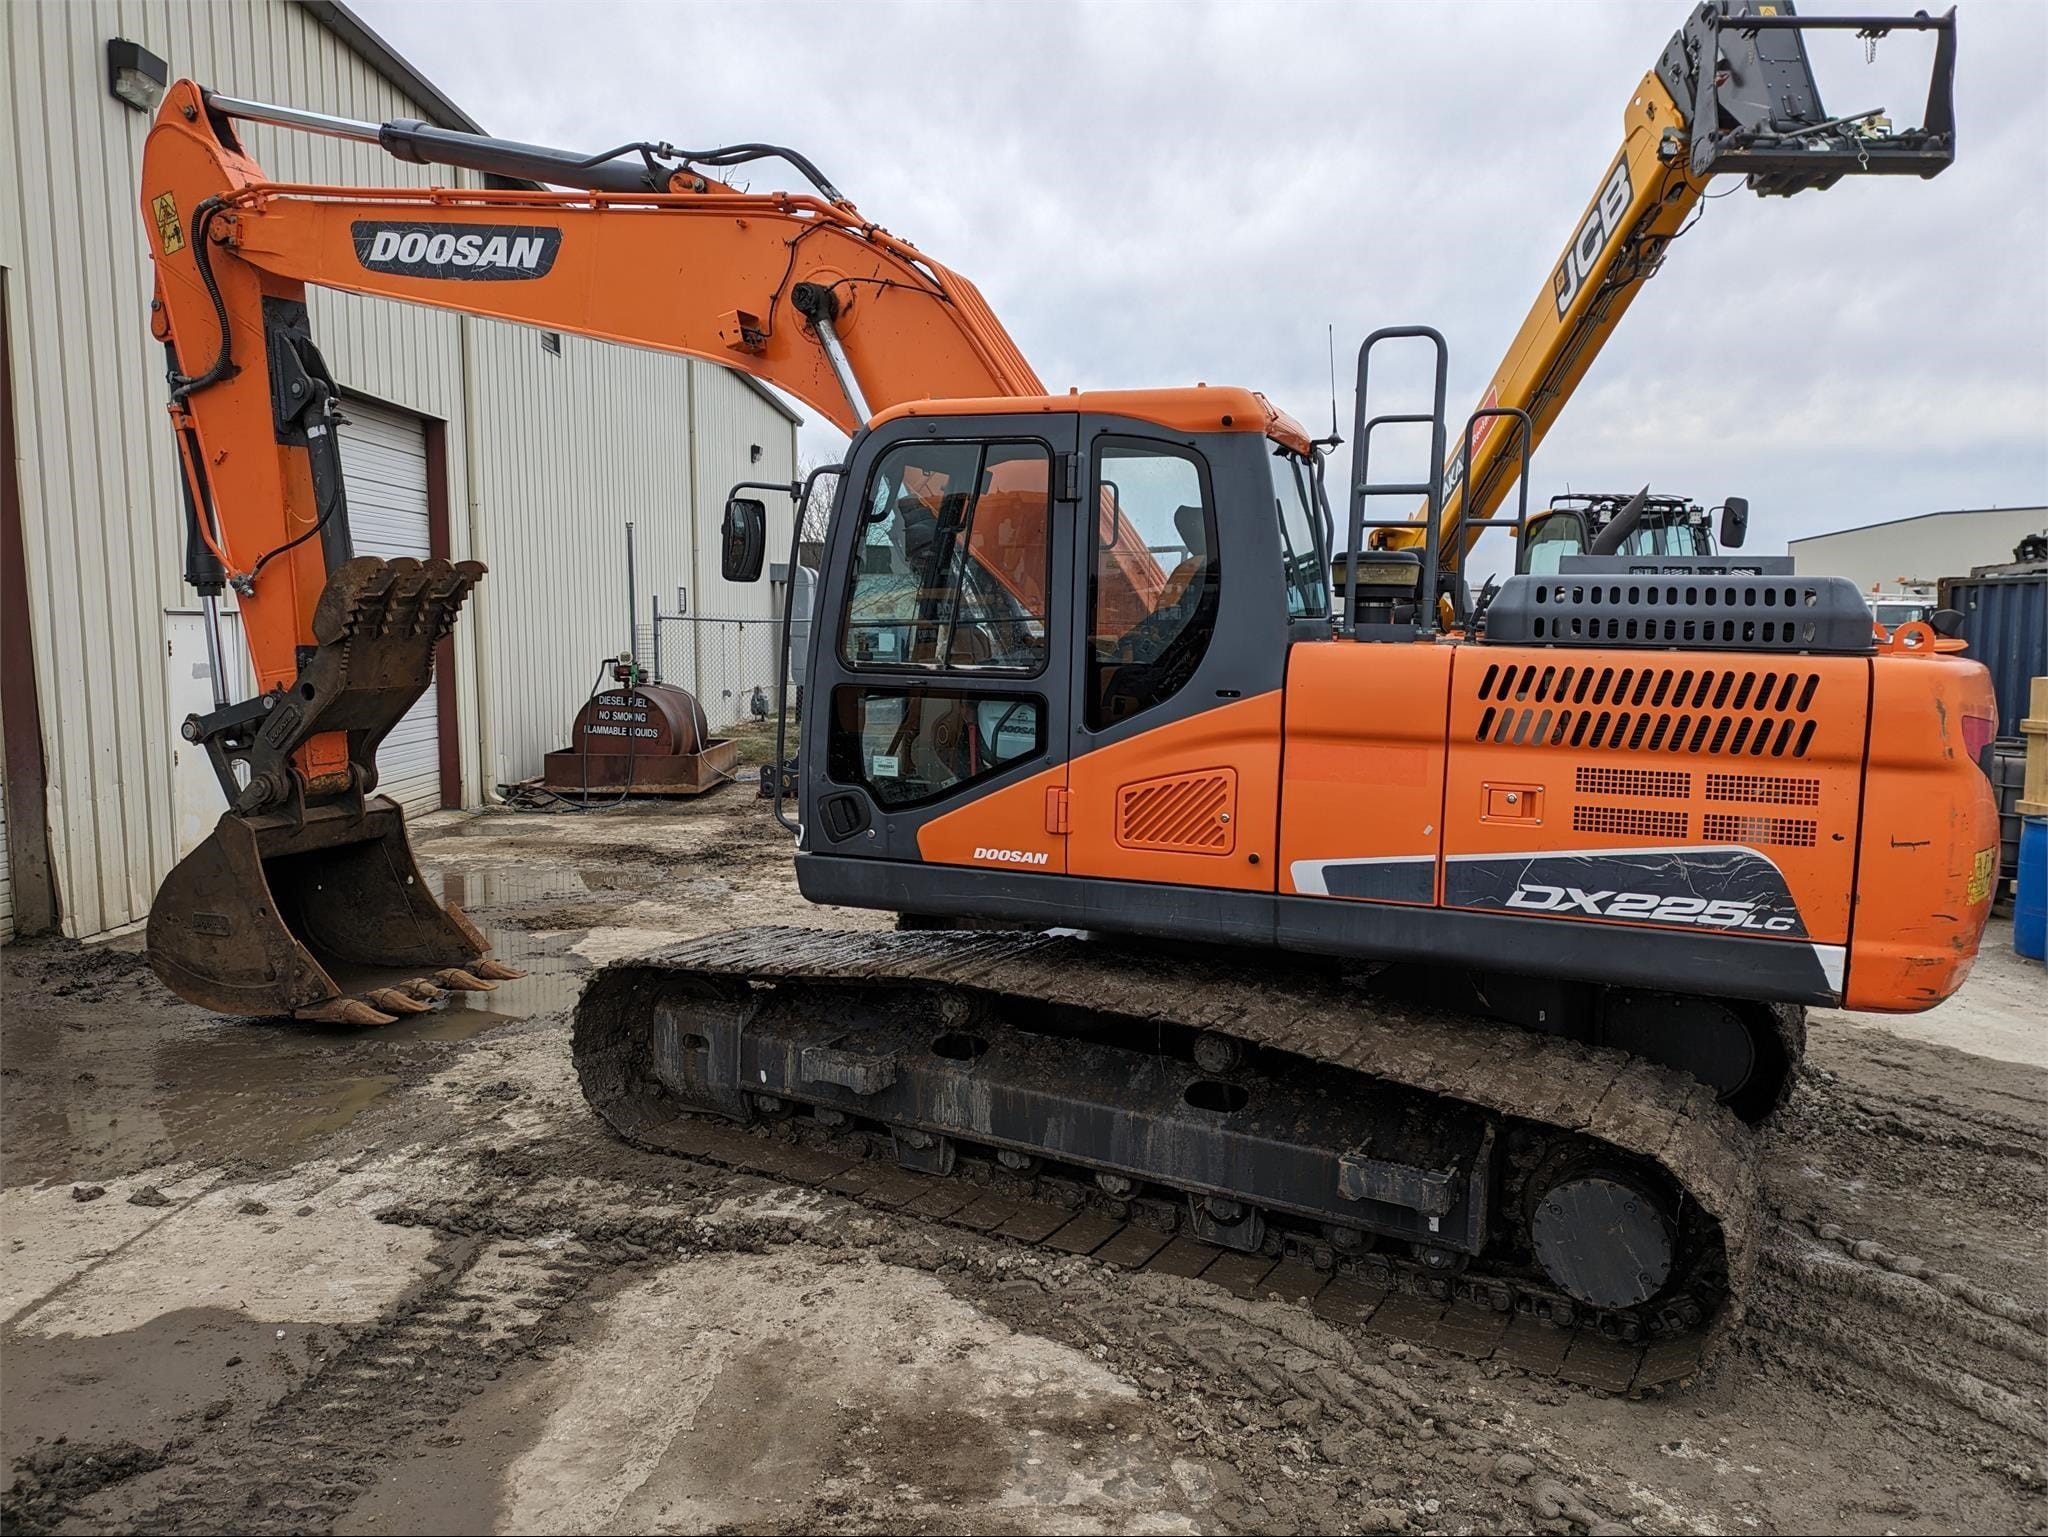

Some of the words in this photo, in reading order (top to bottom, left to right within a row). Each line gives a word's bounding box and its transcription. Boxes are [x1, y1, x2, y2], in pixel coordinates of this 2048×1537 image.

[1558, 164, 1631, 312] JCB
[369, 231, 545, 268] DOOSAN
[599, 695, 626, 706] DIESEL
[598, 711, 610, 720] NO
[612, 711, 646, 723] SMOKNG
[629, 727, 658, 738] LQUIDS
[973, 847, 1049, 864] DOOSAN
